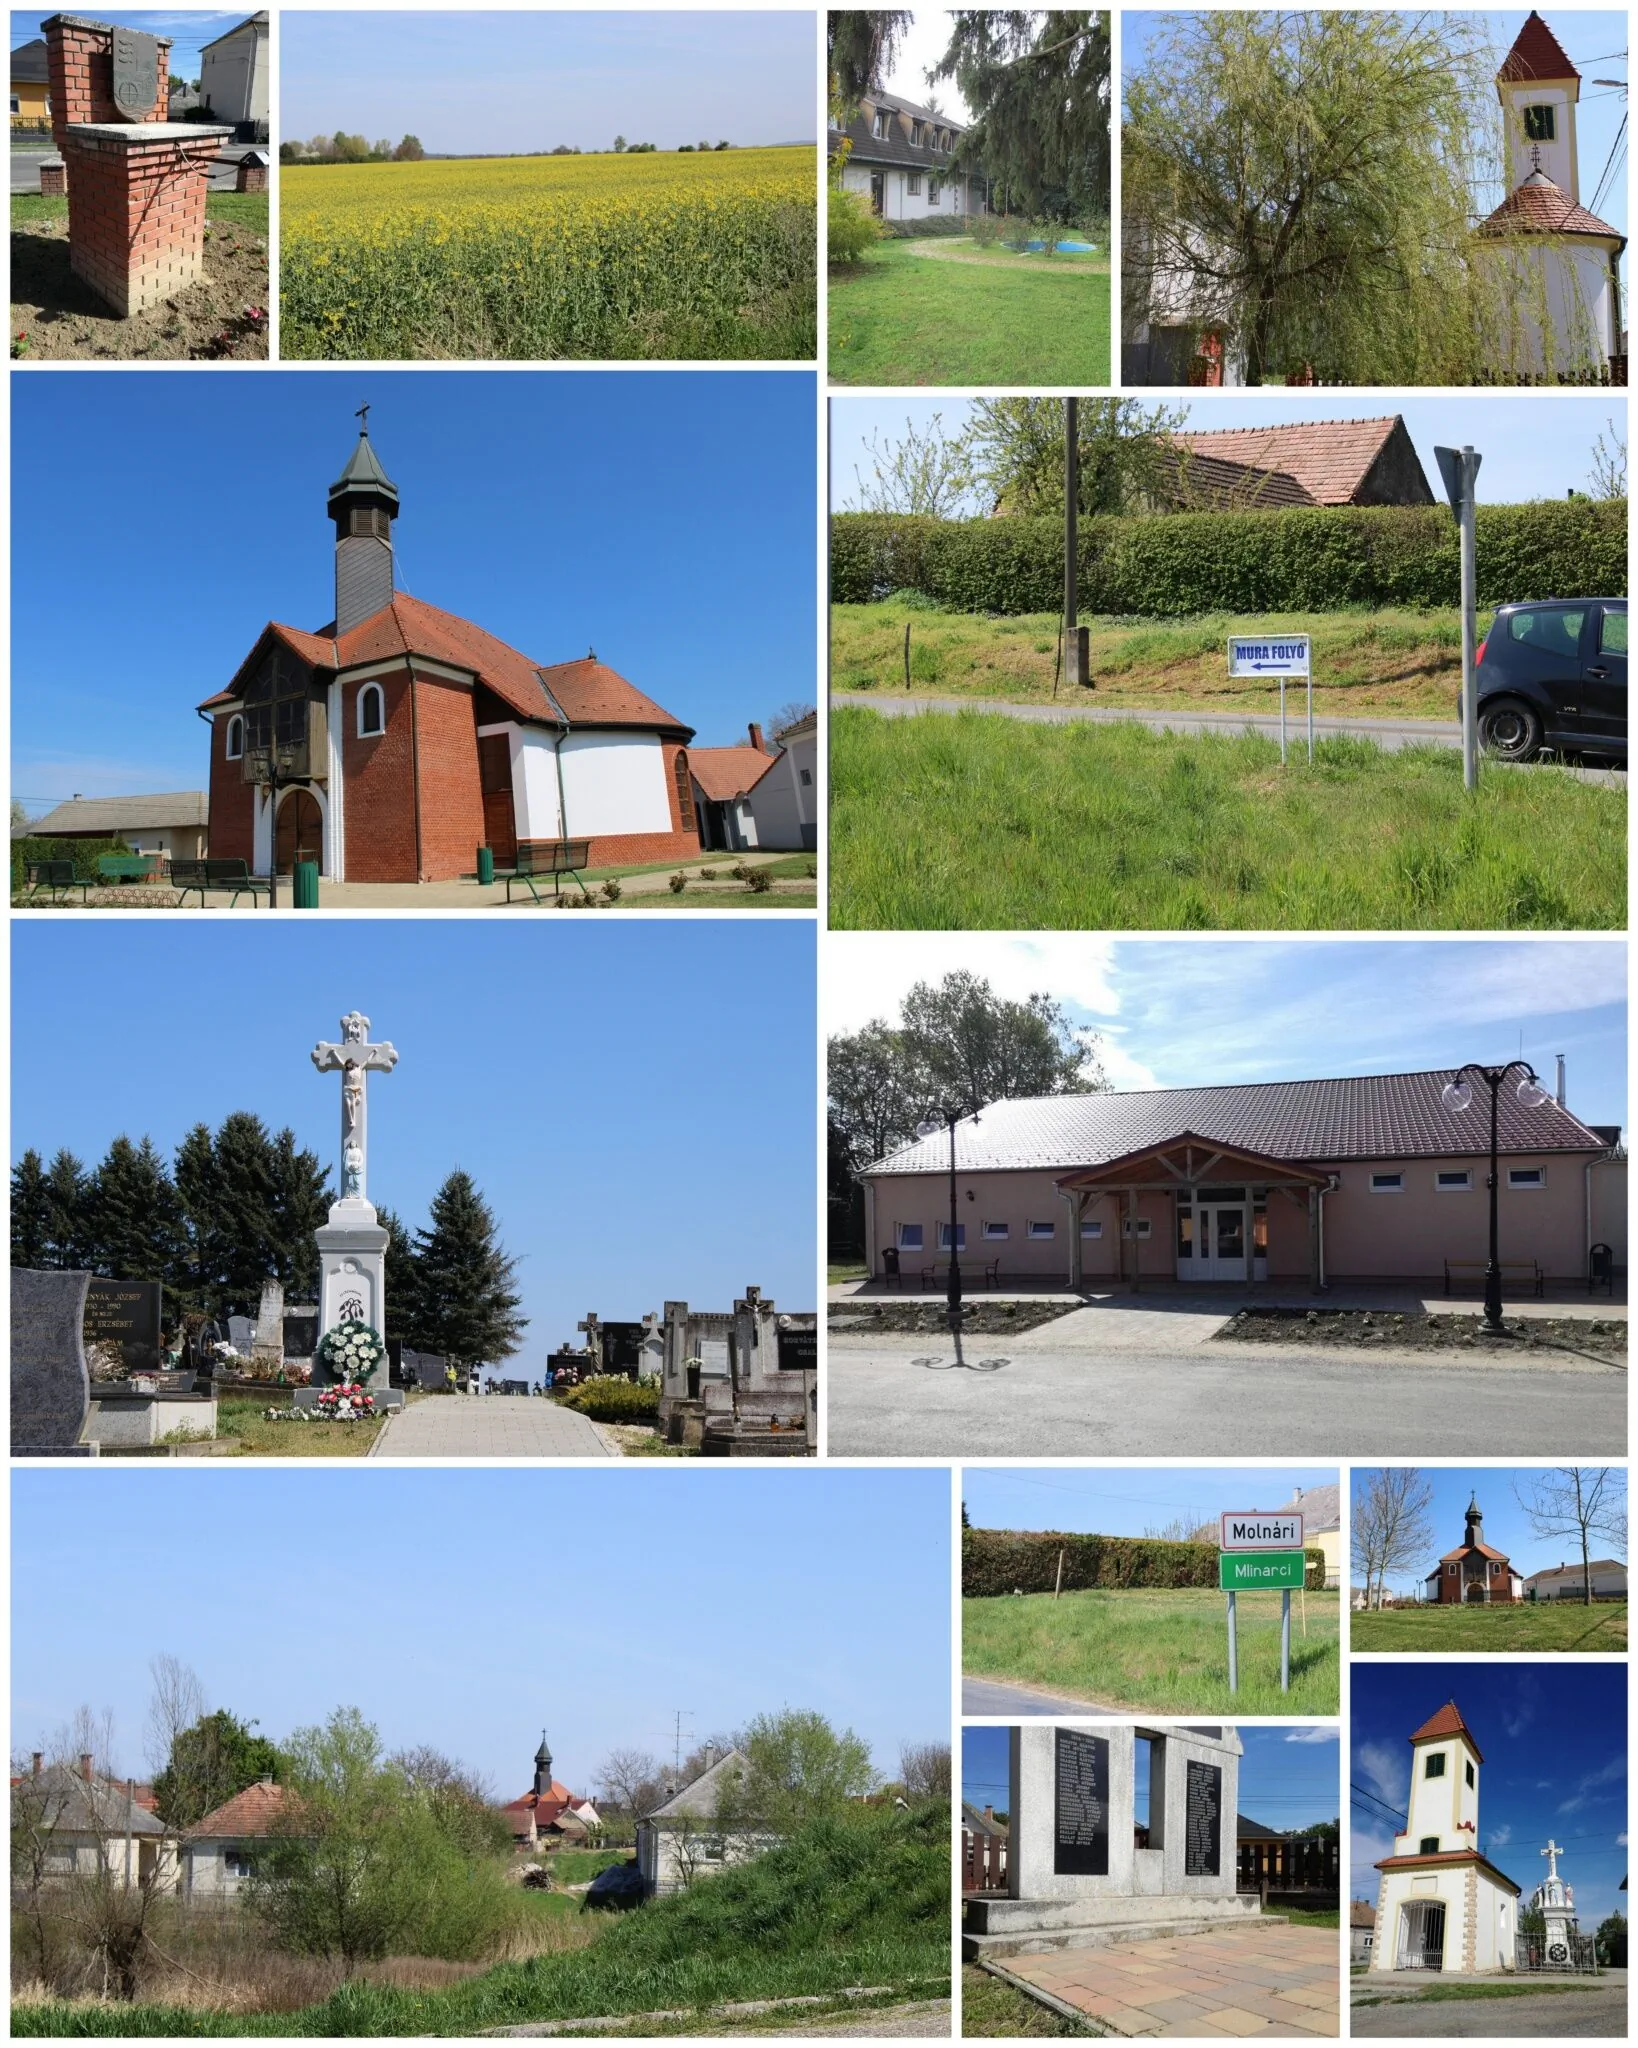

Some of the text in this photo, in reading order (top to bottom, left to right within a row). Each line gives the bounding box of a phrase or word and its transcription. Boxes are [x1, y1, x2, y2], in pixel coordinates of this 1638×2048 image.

[1236, 643, 1307, 660] MURA FOLYÓ
[97, 1318, 134, 1328] ERZSÉBET
[1233, 1521, 1294, 1540] Molnári
[1235, 1563, 1291, 1578] Mlinarci
